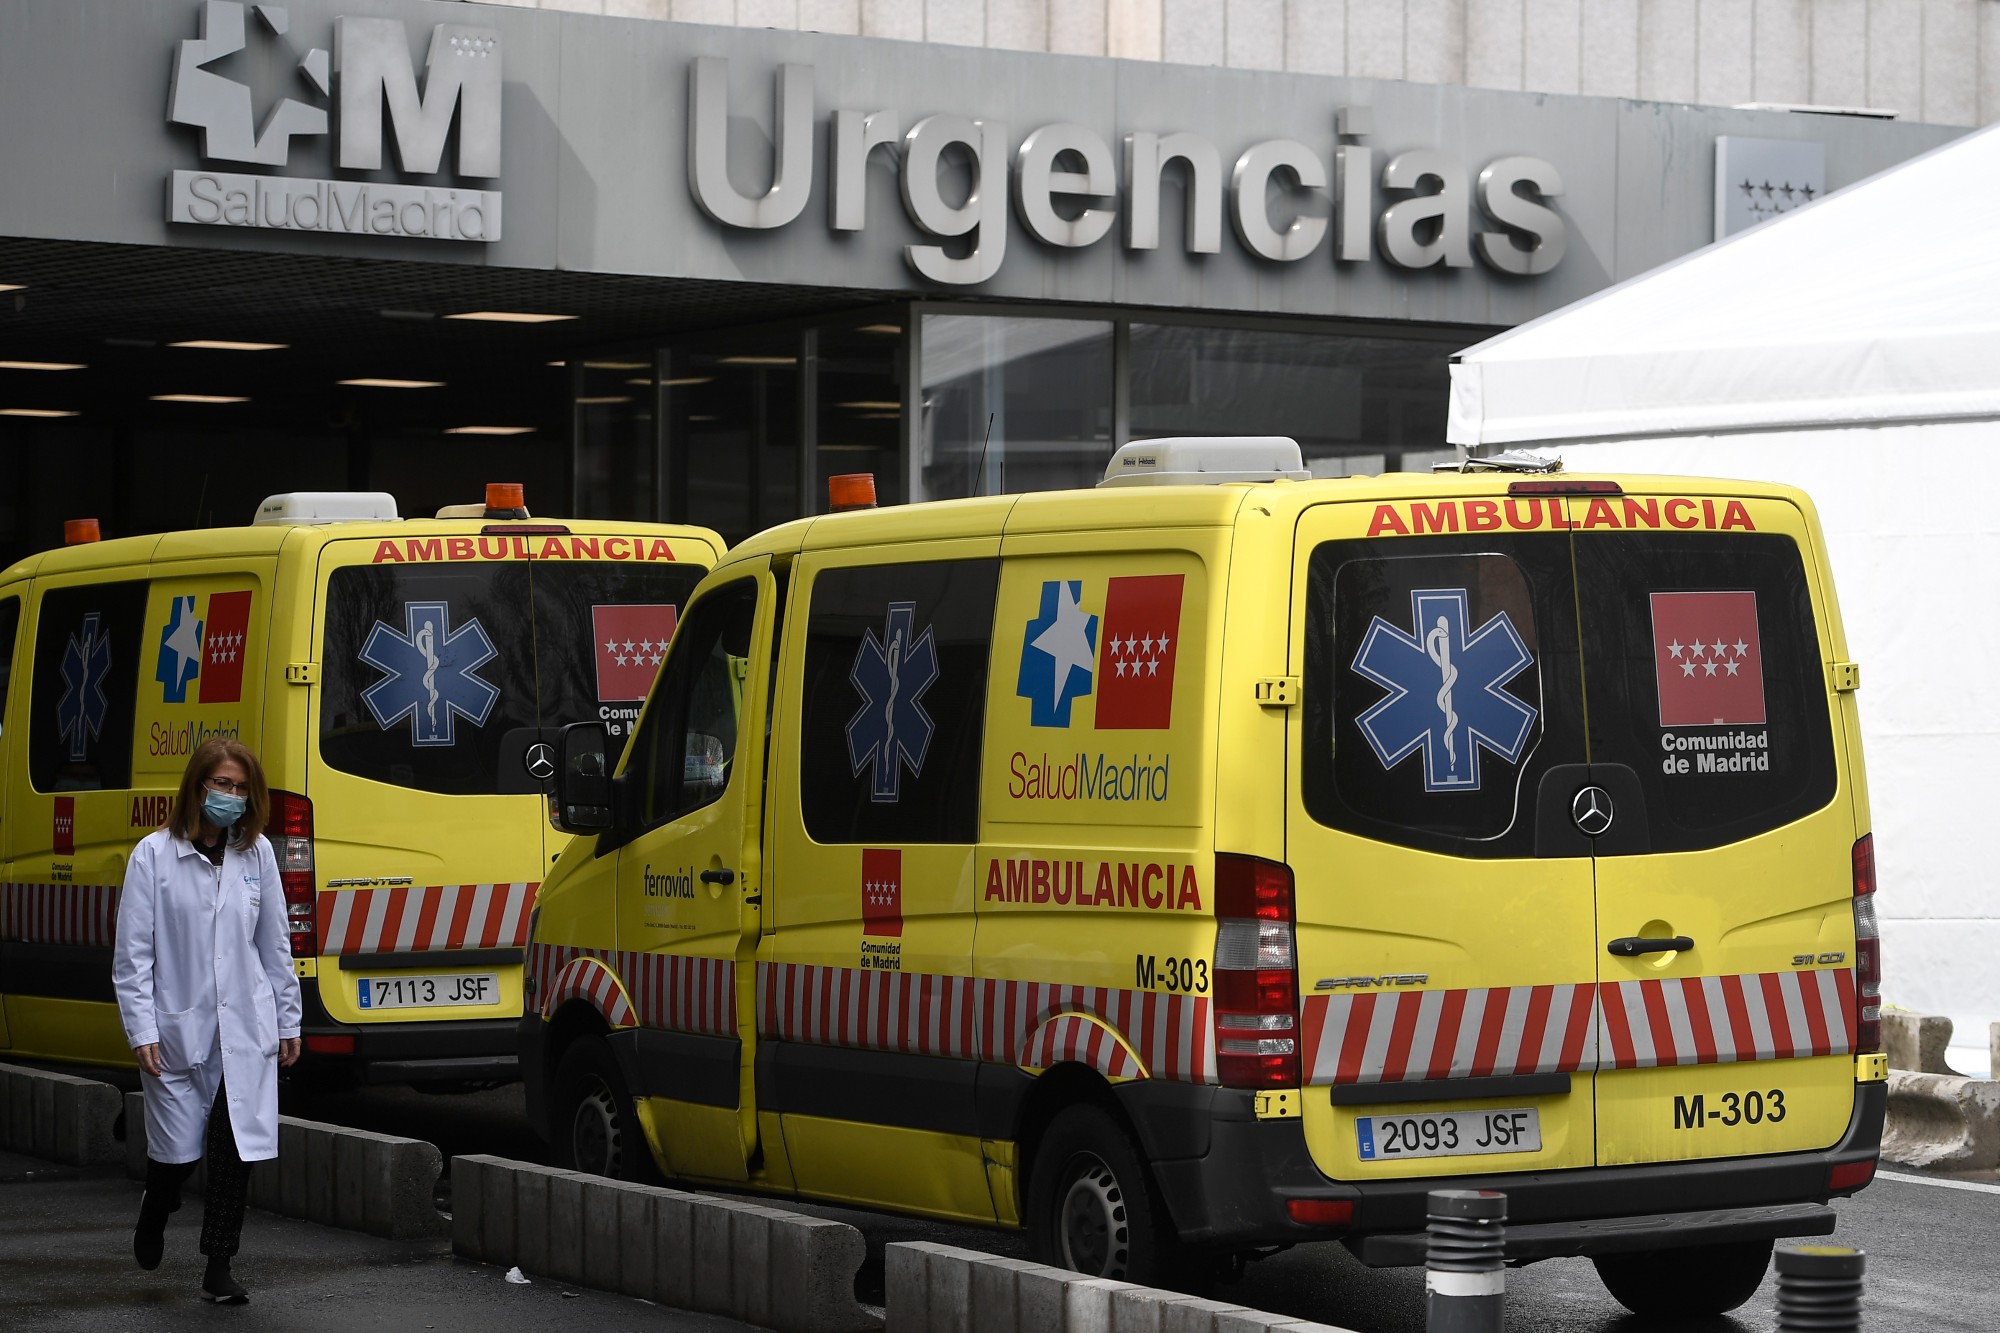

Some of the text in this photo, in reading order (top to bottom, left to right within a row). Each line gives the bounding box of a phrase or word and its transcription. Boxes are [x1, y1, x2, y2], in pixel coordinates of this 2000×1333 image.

[689, 56, 1567, 284] Urgencias
[188, 174, 487, 241] SaludMadrid
[1366, 498, 1756, 536] AMBULANCIA
[372, 537, 676, 563] AMBULANCIA
[1661, 731, 1768, 751] Comunidad
[1009, 752, 1169, 801] SaludMadrid
[1663, 752, 1769, 774] de Madrid
[327, 877, 414, 888] SPRINTER
[644, 864, 694, 899] ferrovial
[985, 859, 1202, 910] AMBULANCIA
[861, 941, 901, 954] Comunidad
[861, 955, 900, 969] de Madrid
[1136, 954, 1208, 993] M-303
[1314, 974, 1428, 990] SPRINTER
[376, 979, 436, 1005] 7113
[449, 978, 490, 1001] JSF
[1674, 1089, 1786, 1130] M-303
[1363, 1113, 1528, 1153] E 2093 JSF
